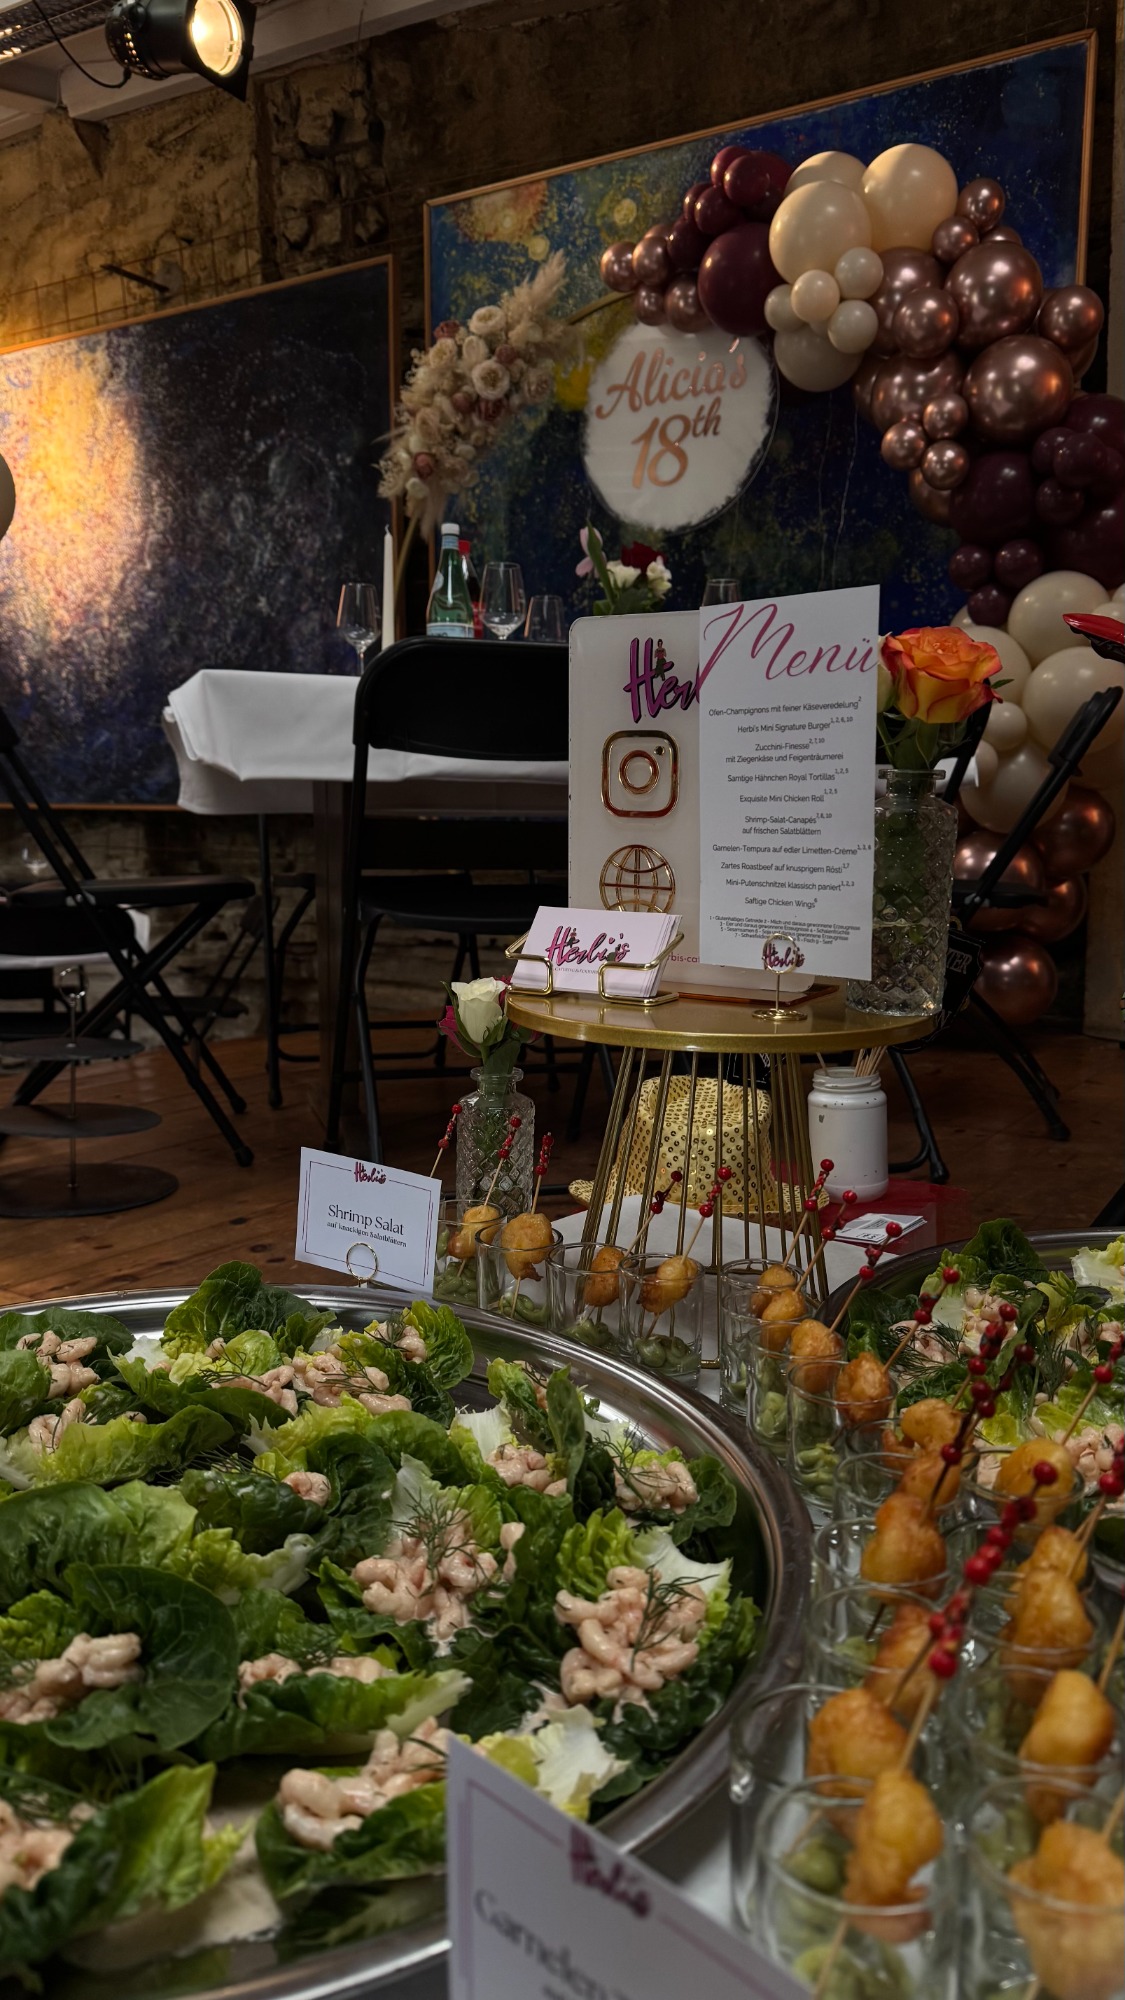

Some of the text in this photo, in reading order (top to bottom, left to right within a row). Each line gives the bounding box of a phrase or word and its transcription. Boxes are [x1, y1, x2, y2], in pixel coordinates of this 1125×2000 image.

[631, 396, 722, 489] 18th
[699, 603, 878, 689] Menü
[623, 637, 700, 724] Her
[708, 707, 769, 717] Ofen-Champignons
[771, 705, 781, 713] mit
[782, 704, 801, 712] feiner
[803, 701, 859, 711] Käseveredelung
[737, 724, 759, 733] Herbi's
[760, 724, 774, 732] Mini
[775, 722, 806, 733] Signature
[808, 721, 831, 731] Burger
[755, 743, 810, 751] Zucchini-Finesse
[737, 755, 774, 764] Ziegenkäse
[774, 754, 788, 762] und
[789, 752, 844, 763] Feigenträumerei
[728, 774, 753, 783] Samtige
[789, 773, 807, 782] Royal
[740, 795, 768, 803] Exquisite
[745, 816, 816, 825] Shrimp-Salat-Canapés
[780, 827, 821, 836] Salatblättern
[742, 862, 773, 870] Roastbeef
[786, 864, 824, 874] knusprigem
[826, 865, 842, 874] Rösti
[726, 879, 786, 888] Mini-Putenschnitzel
[788, 882, 816, 890] klassisch
[818, 883, 841, 892] paniert
[745, 897, 767, 906] Saftige
[768, 898, 793, 906] Chicken
[795, 900, 815, 909] Wings
[328, 1204, 404, 1236] Shrimp Salat
